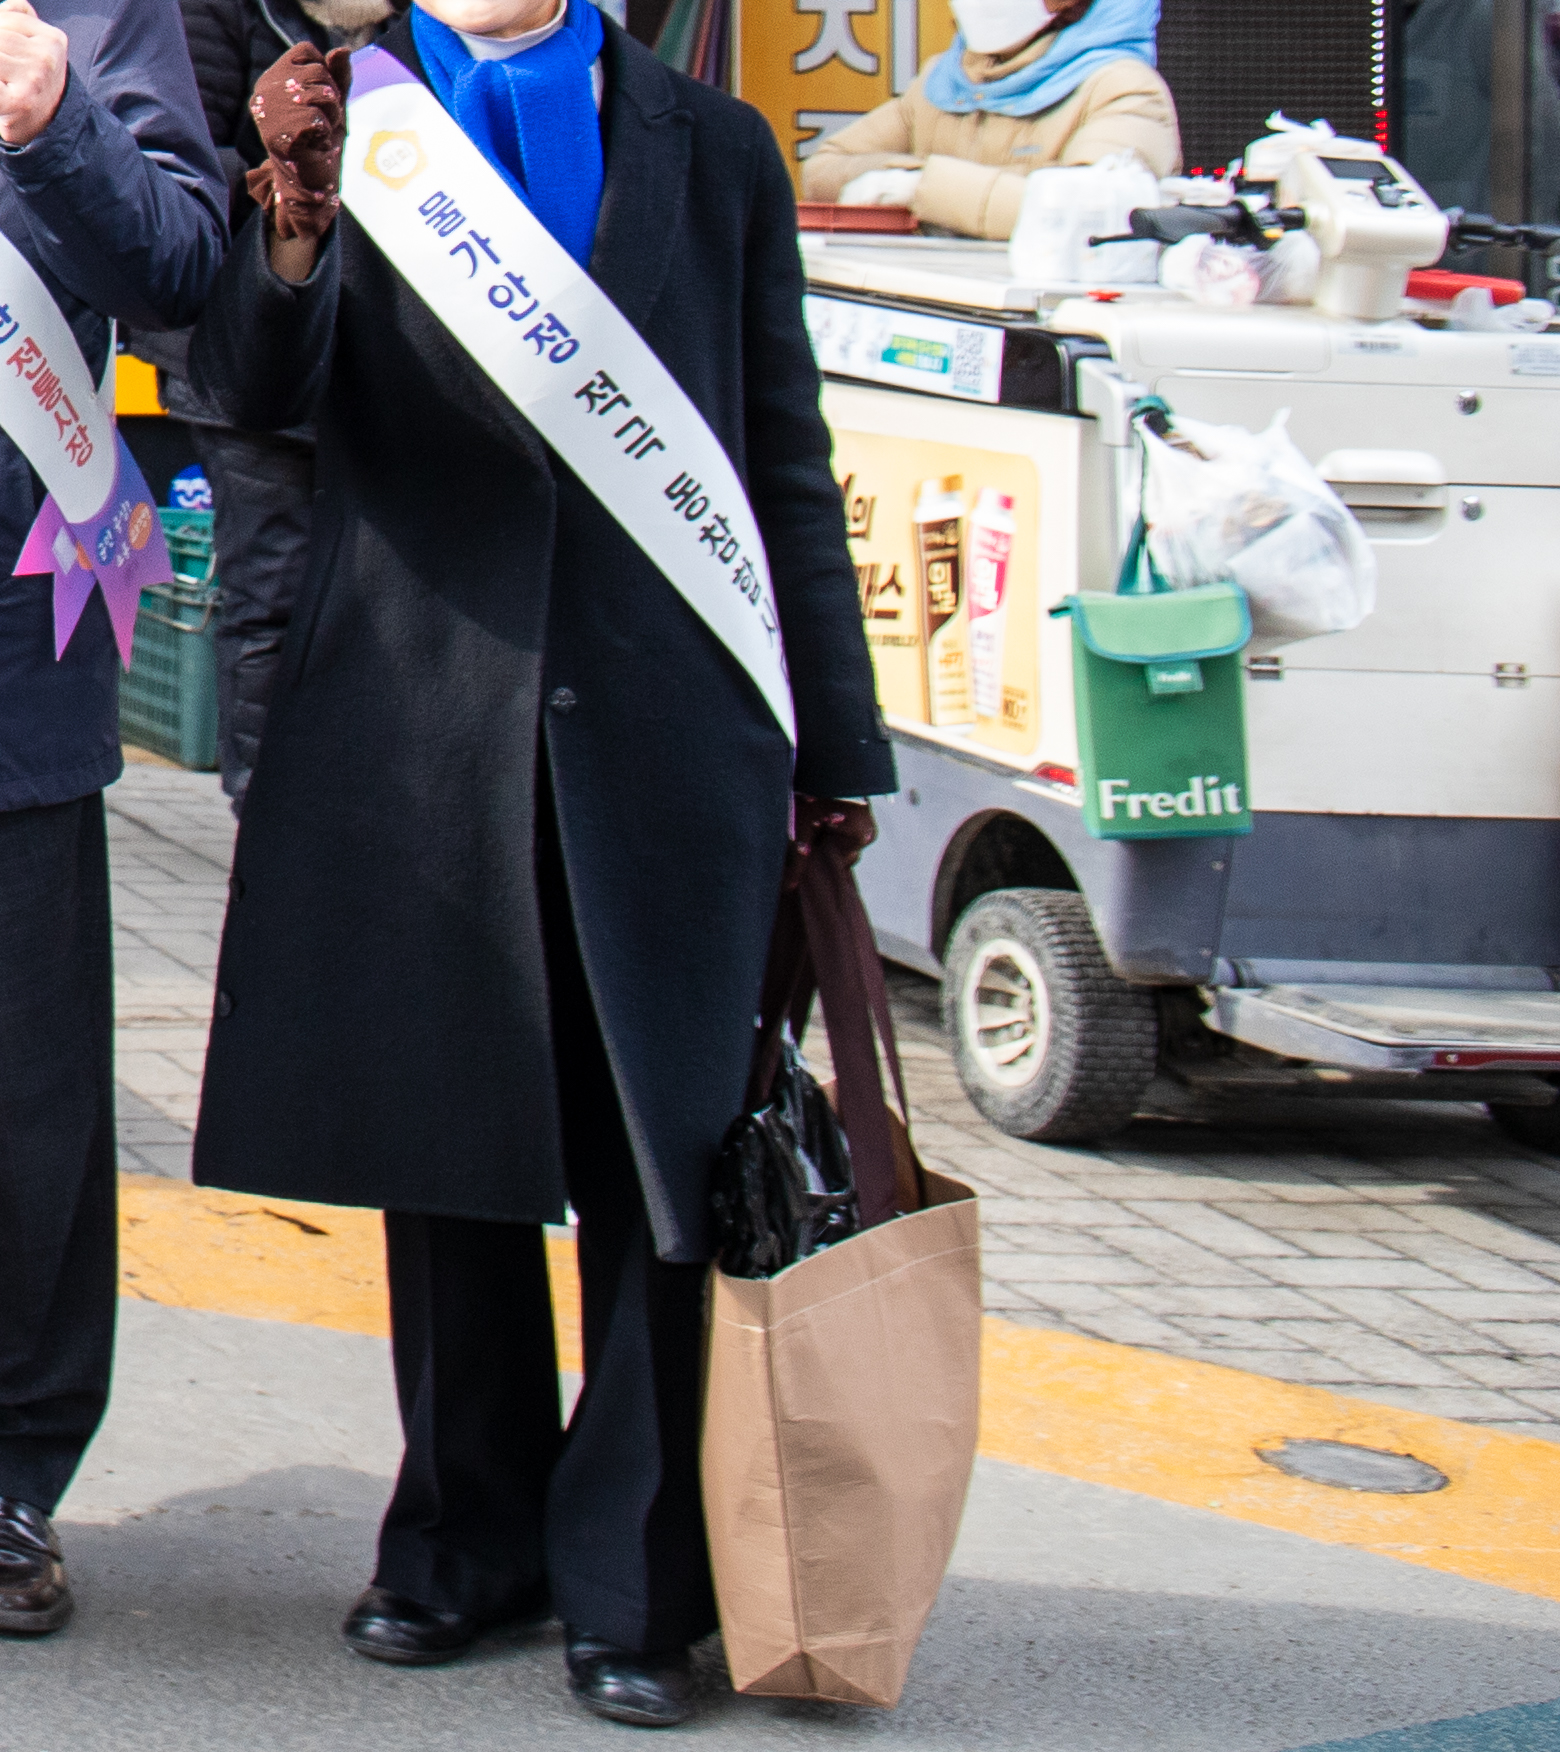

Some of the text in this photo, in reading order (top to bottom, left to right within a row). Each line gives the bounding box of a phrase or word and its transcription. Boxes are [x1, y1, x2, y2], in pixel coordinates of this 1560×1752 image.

[418, 191, 582, 364] 물가안정
[574, 369, 667, 462] 적극
[6, 336, 95, 468] 전통시장
[1099, 777, 1243, 821] Fredit
